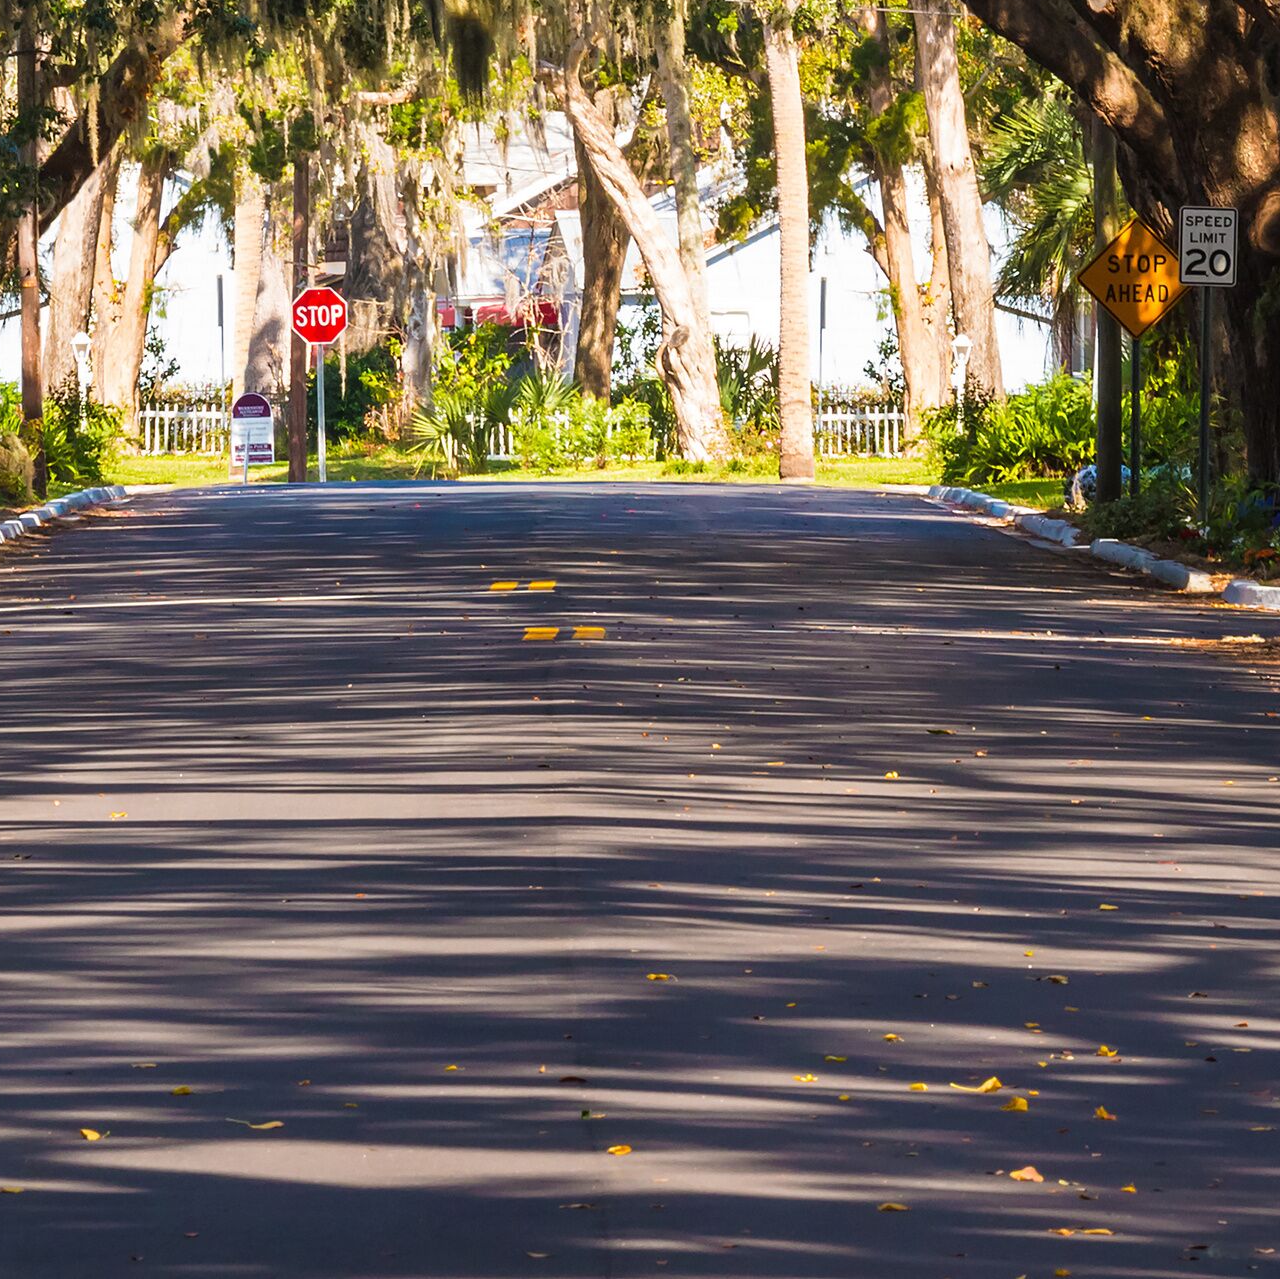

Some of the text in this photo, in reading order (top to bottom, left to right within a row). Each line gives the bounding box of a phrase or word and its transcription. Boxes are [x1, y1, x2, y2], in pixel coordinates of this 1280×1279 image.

[1185, 215, 1233, 228] SPEED
[1189, 232, 1227, 244] LIMIT
[1107, 254, 1167, 273] STOP
[1185, 248, 1232, 277] 20
[1105, 283, 1169, 303] AHEAD
[295, 304, 344, 328] STOP
